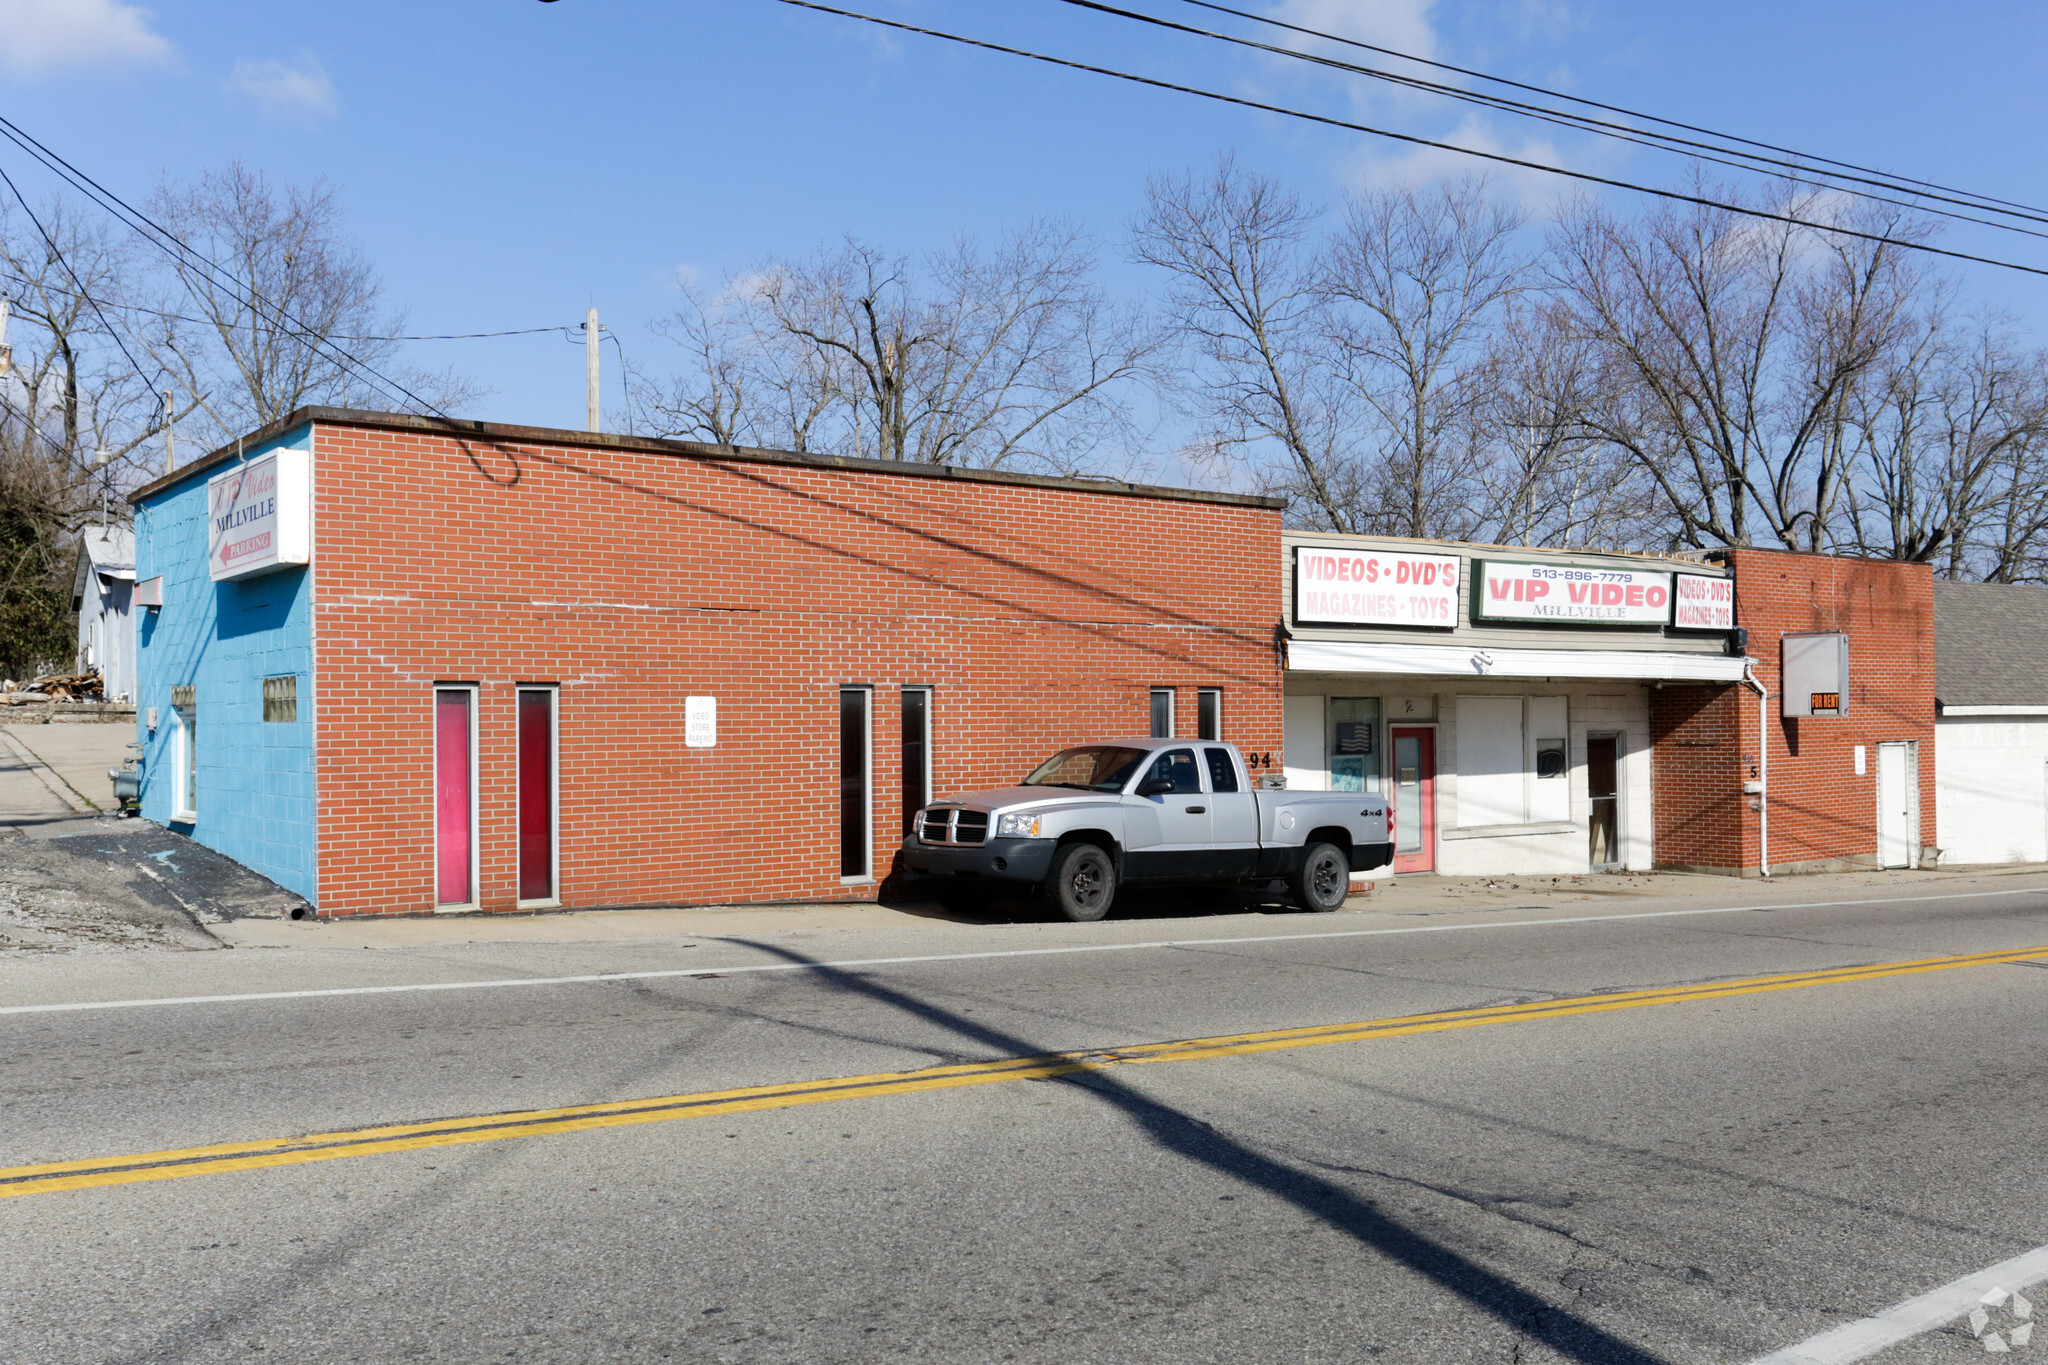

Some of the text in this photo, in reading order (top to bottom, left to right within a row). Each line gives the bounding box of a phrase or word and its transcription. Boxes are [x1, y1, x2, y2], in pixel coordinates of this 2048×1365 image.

[245, 470, 275, 499] Video
[216, 497, 274, 534] MILLVILLE
[230, 534, 269, 558] PARKING
[1303, 555, 1456, 587] VIDEOS DVD'S
[1532, 568, 1633, 583] 513-896-7779
[1488, 576, 1667, 608] VIP VIDEO
[1679, 578, 1731, 602] VIDEOS DVD'S
[1306, 591, 1449, 621] MAGAZINES TOYS
[1532, 604, 1627, 618] MILLVILLE
[1678, 604, 1730, 626] MAGAZINES TOYS
[1811, 694, 1839, 708] FOR RENT
[691, 711, 710, 720] VIDEO
[691, 722, 711, 731] STORE
[688, 734, 714, 743] PARKING
[1750, 766, 1757, 778] 5
[1360, 808, 1383, 817] 4x4
